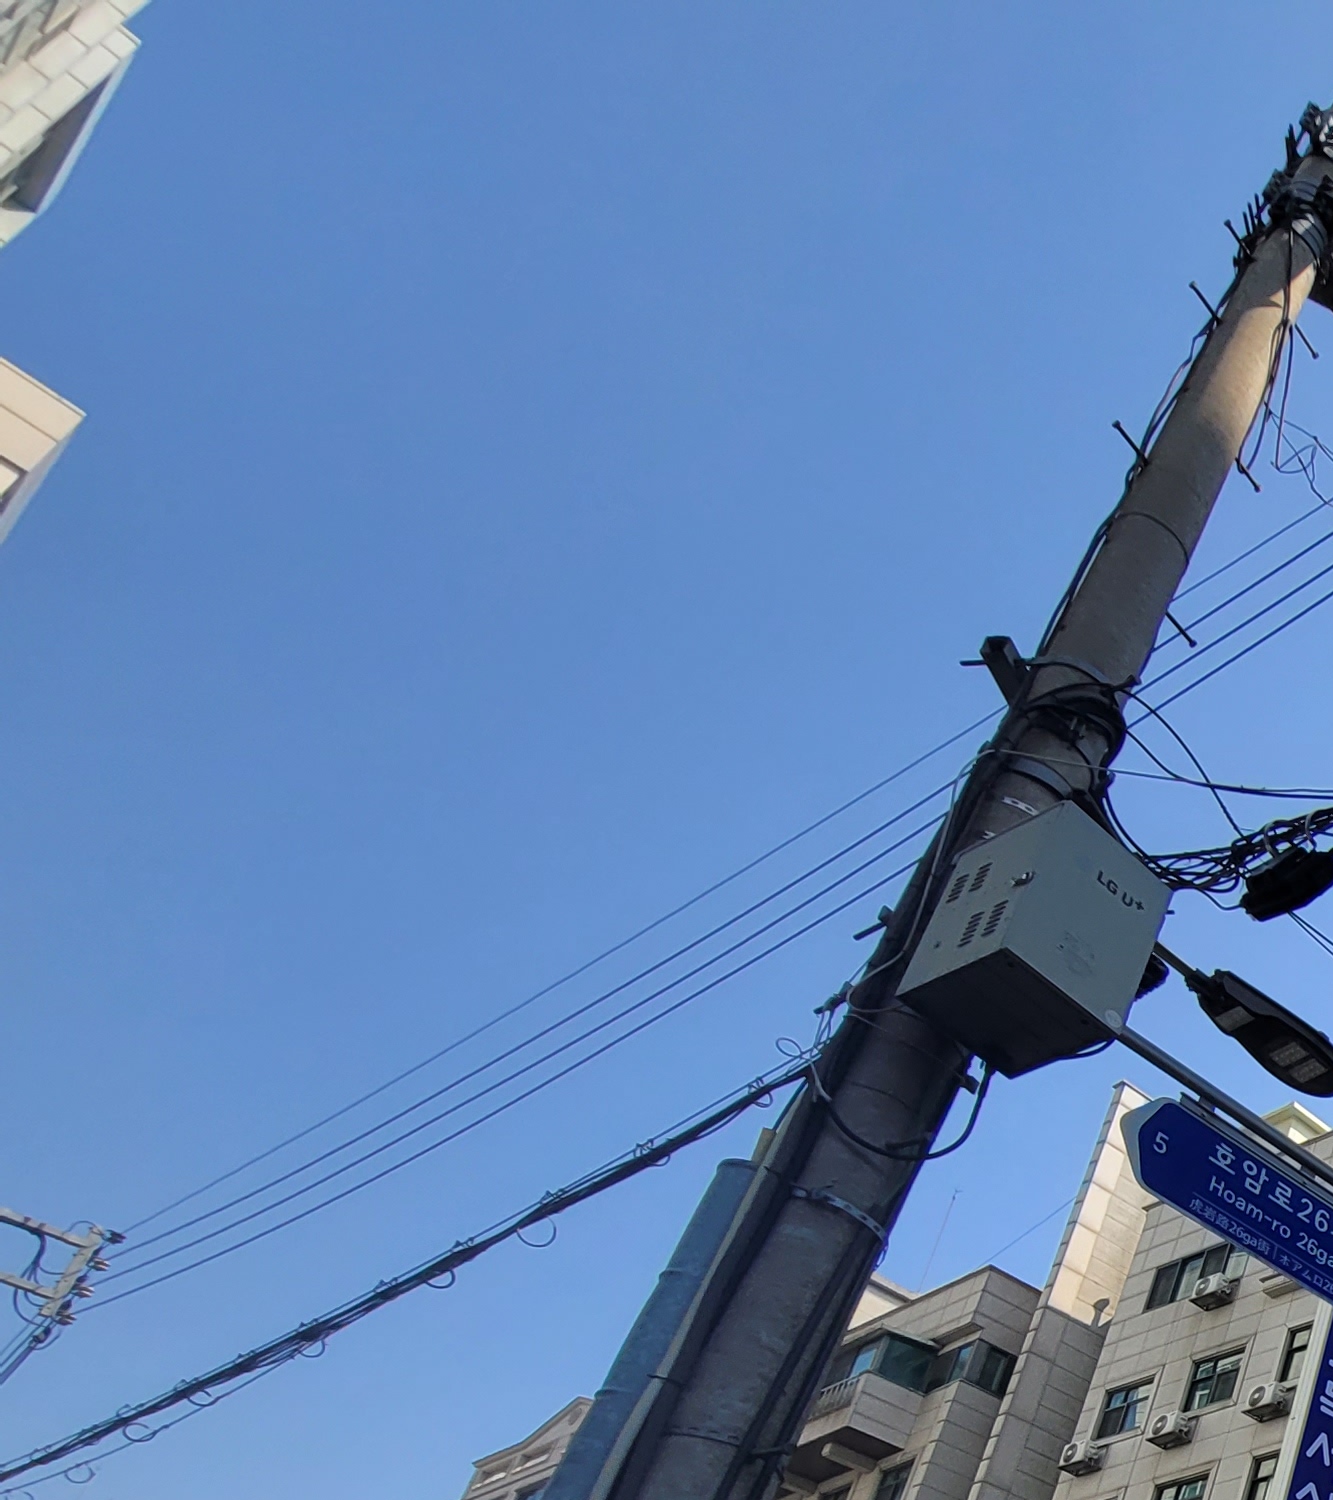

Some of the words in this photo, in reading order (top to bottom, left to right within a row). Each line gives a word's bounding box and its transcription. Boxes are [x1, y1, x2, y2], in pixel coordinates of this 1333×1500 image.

[1096, 870, 1117, 895] LG
[1122, 892, 1145, 911] U+
[1153, 1131, 1168, 1154] 5
[1208, 1175, 1292, 1239] Hoam-ro
